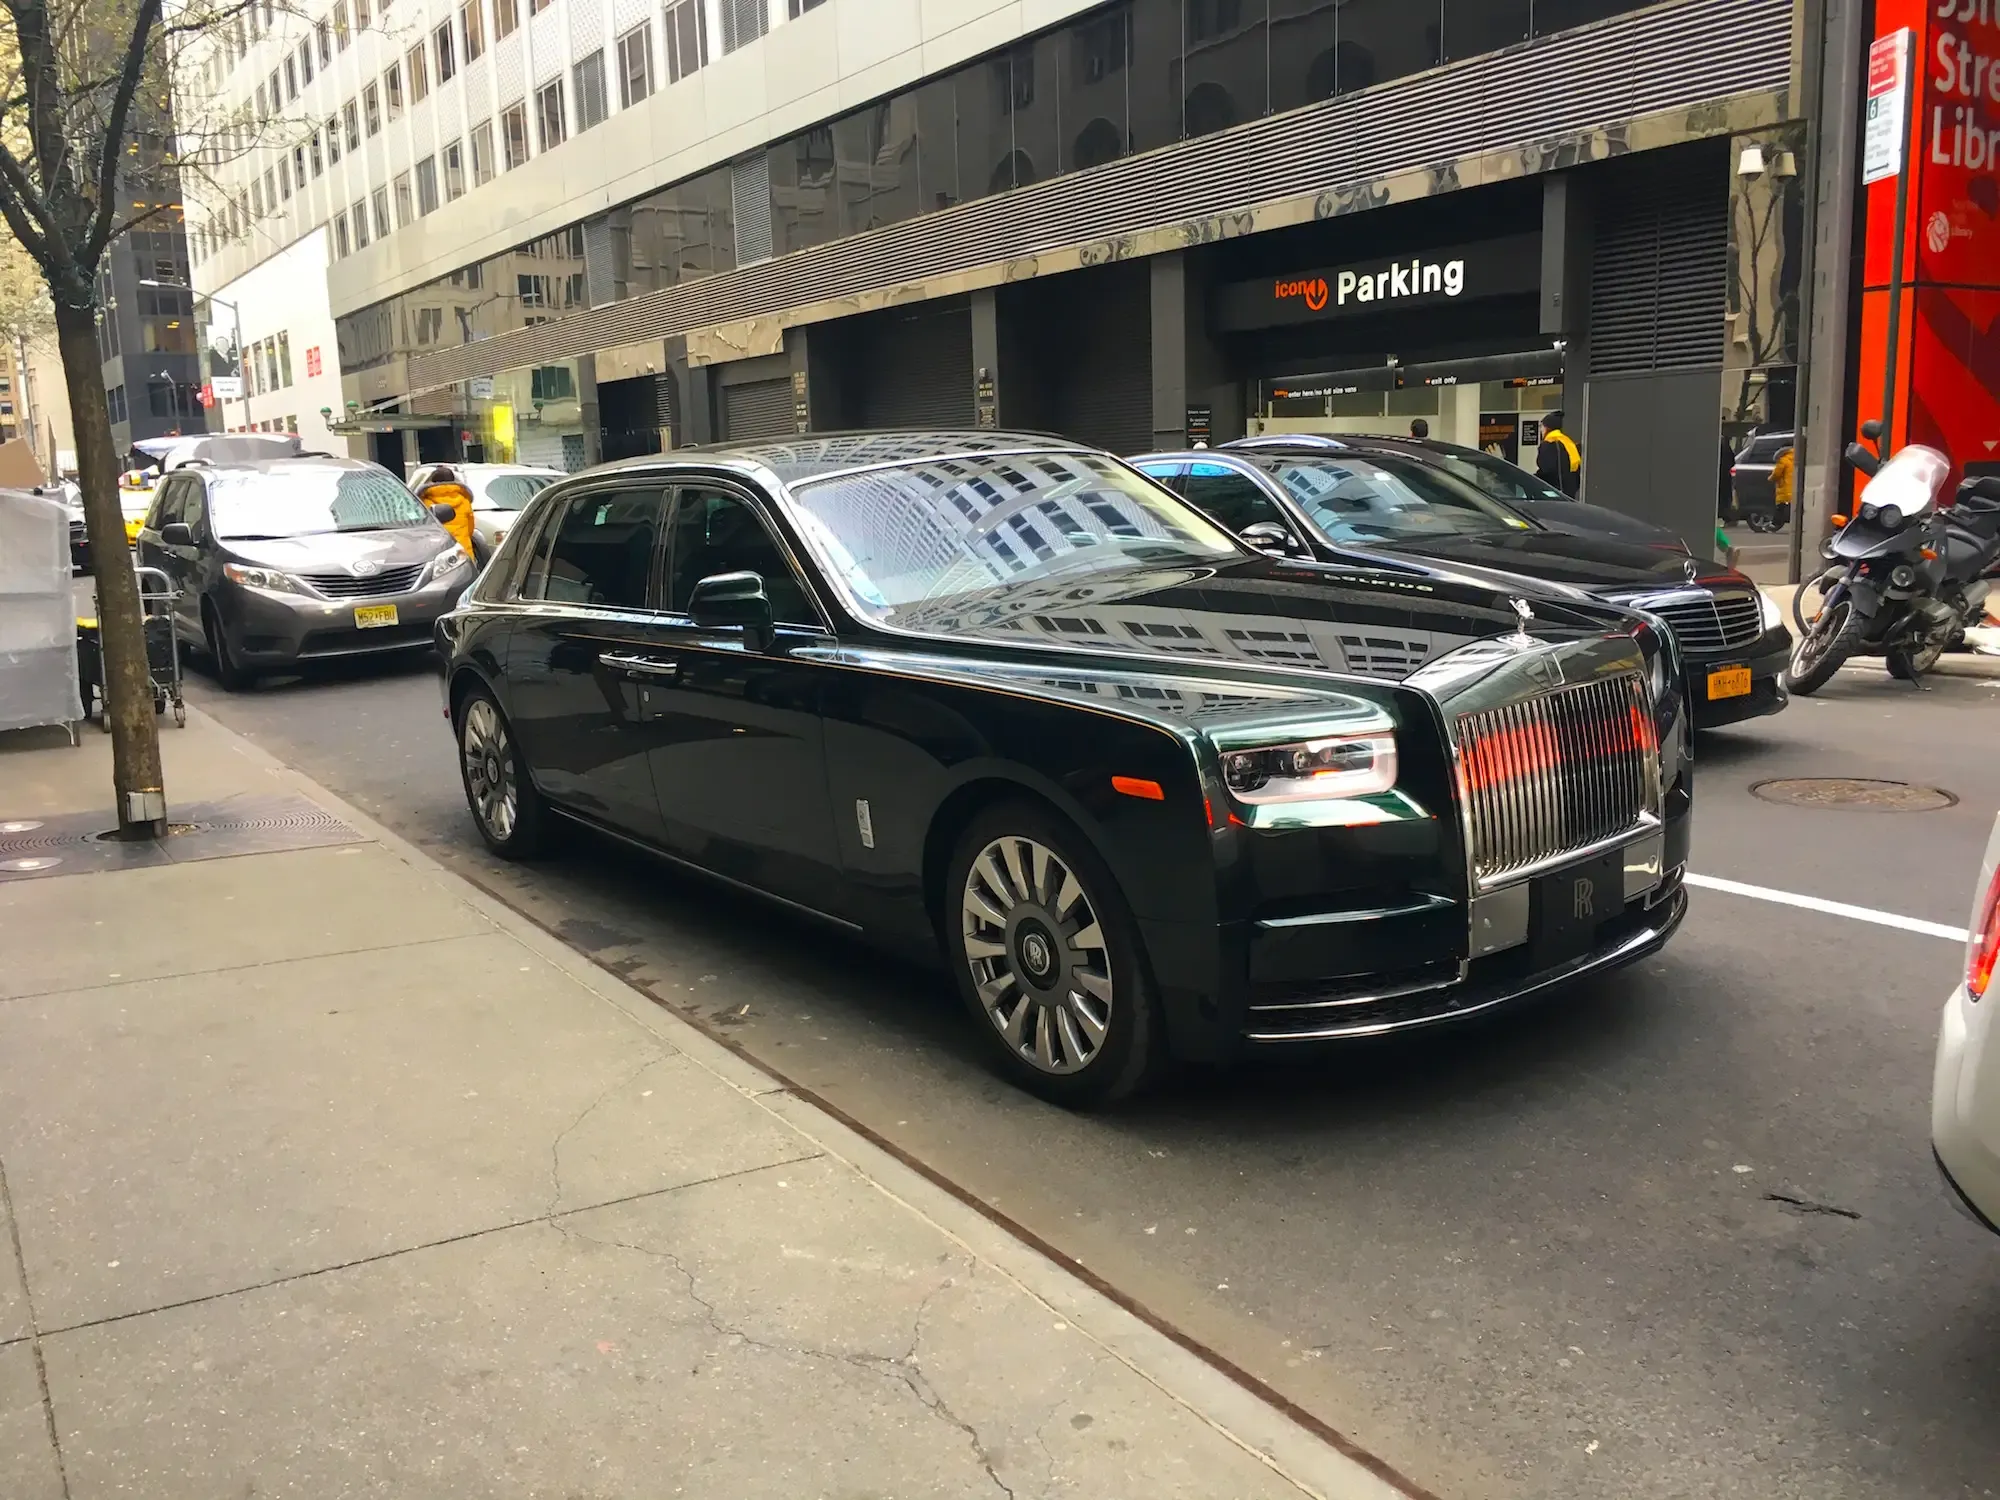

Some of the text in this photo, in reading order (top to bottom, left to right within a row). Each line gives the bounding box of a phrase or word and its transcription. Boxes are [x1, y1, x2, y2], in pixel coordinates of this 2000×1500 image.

[1275, 259, 1464, 305] icon Parking
[1431, 376, 1457, 385] exit only
